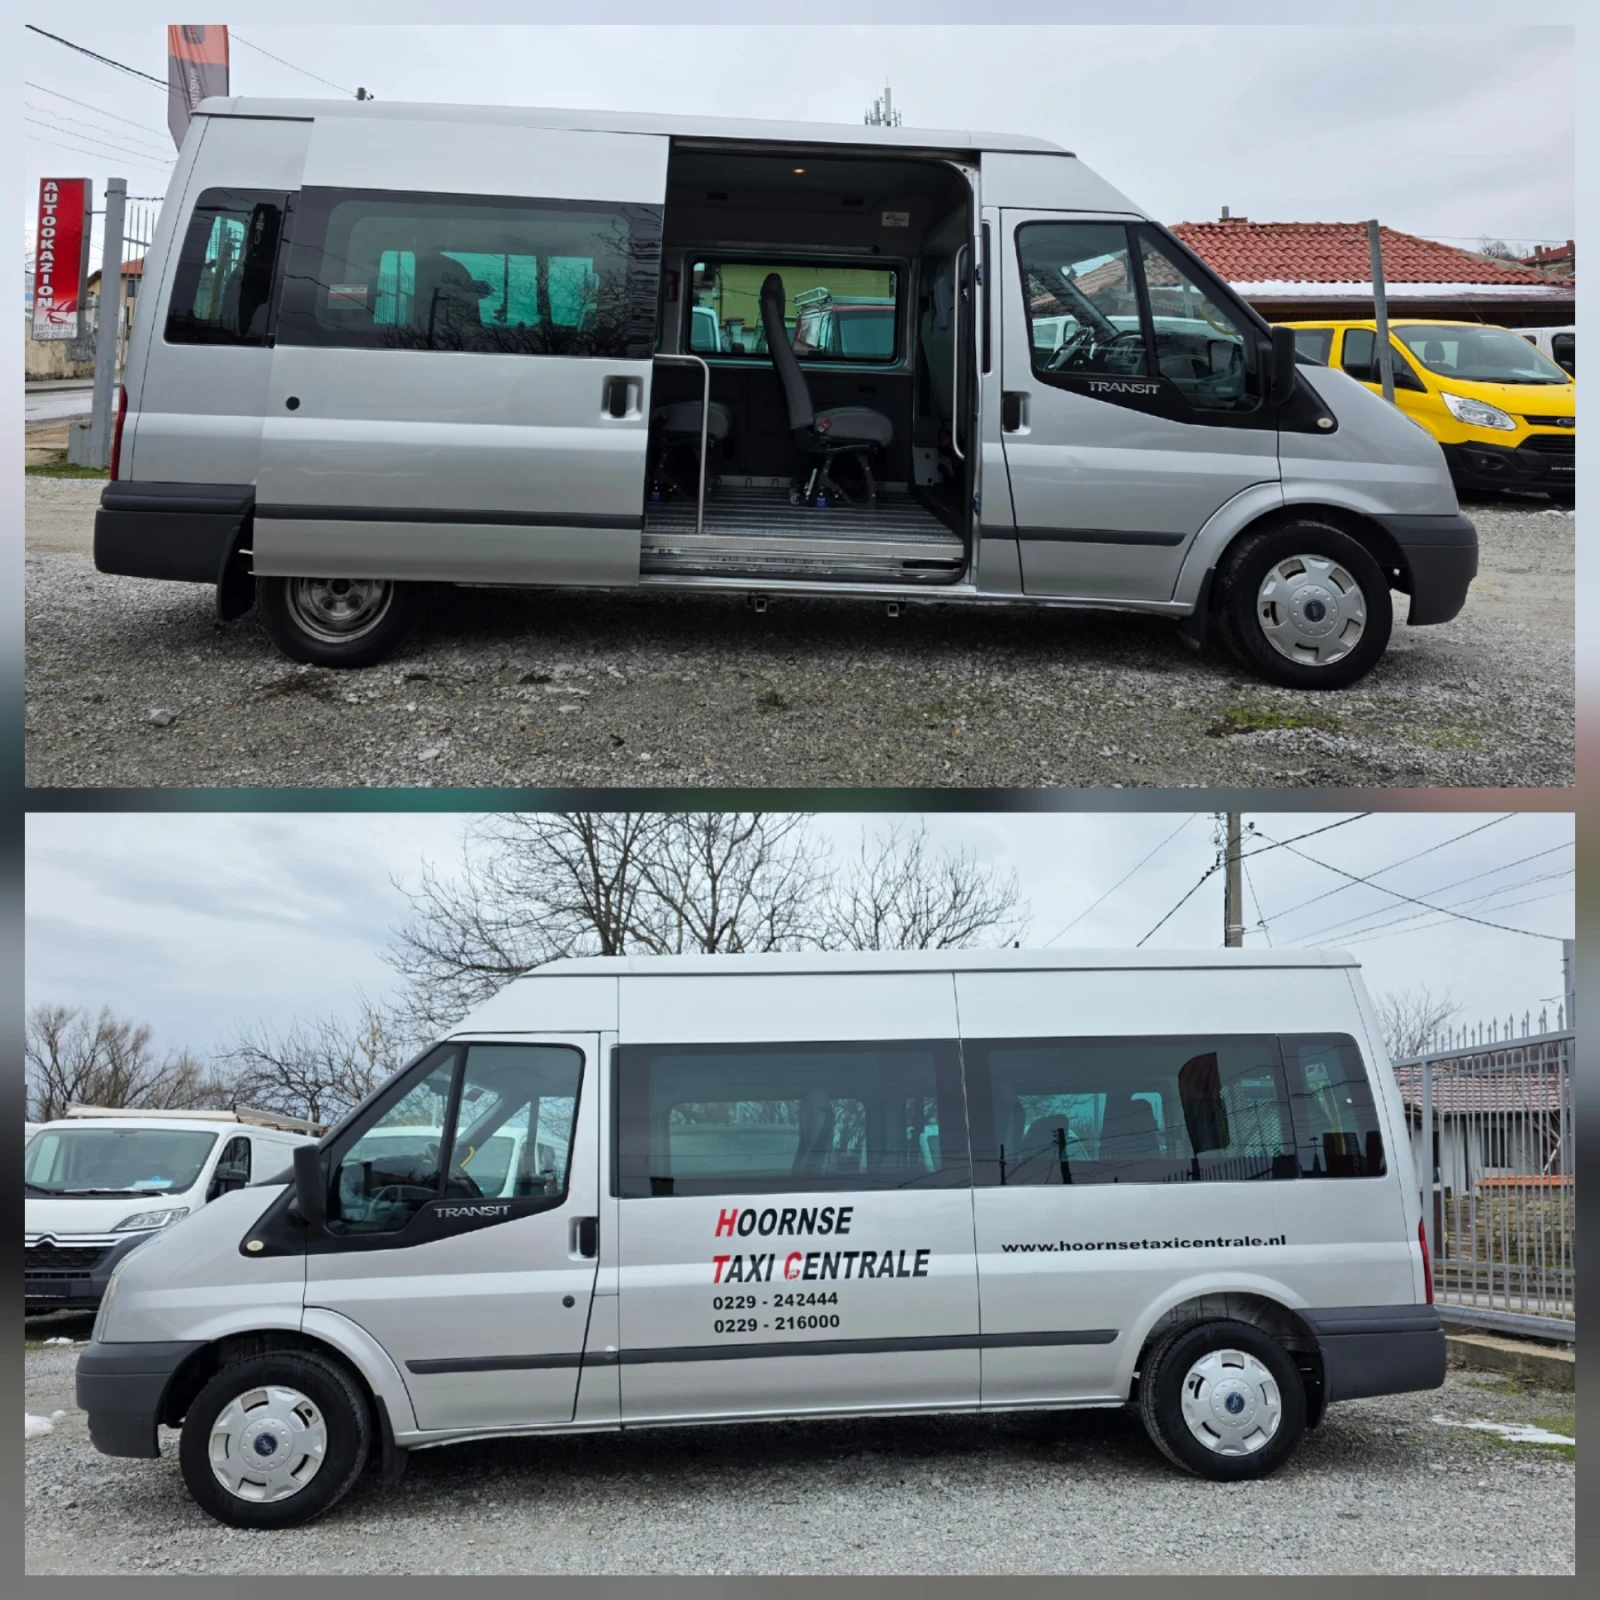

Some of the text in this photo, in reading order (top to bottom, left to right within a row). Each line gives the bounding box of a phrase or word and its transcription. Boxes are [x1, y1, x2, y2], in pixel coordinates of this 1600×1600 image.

[37, 182, 59, 307] AUTOOKAZION
[1087, 381, 1161, 395] TRANSIT
[434, 1204, 512, 1218] TRANSIT
[714, 1206, 854, 1237] HOORNSE
[1001, 1234, 1287, 1253] www.hoornsetaxicentrale.nl
[712, 1249, 931, 1284] TAXI CENTRALE
[713, 1295, 757, 1310] 0229
[773, 1292, 838, 1308] 242444
[714, 1318, 758, 1333] 0229
[774, 1314, 840, 1331] 216000
